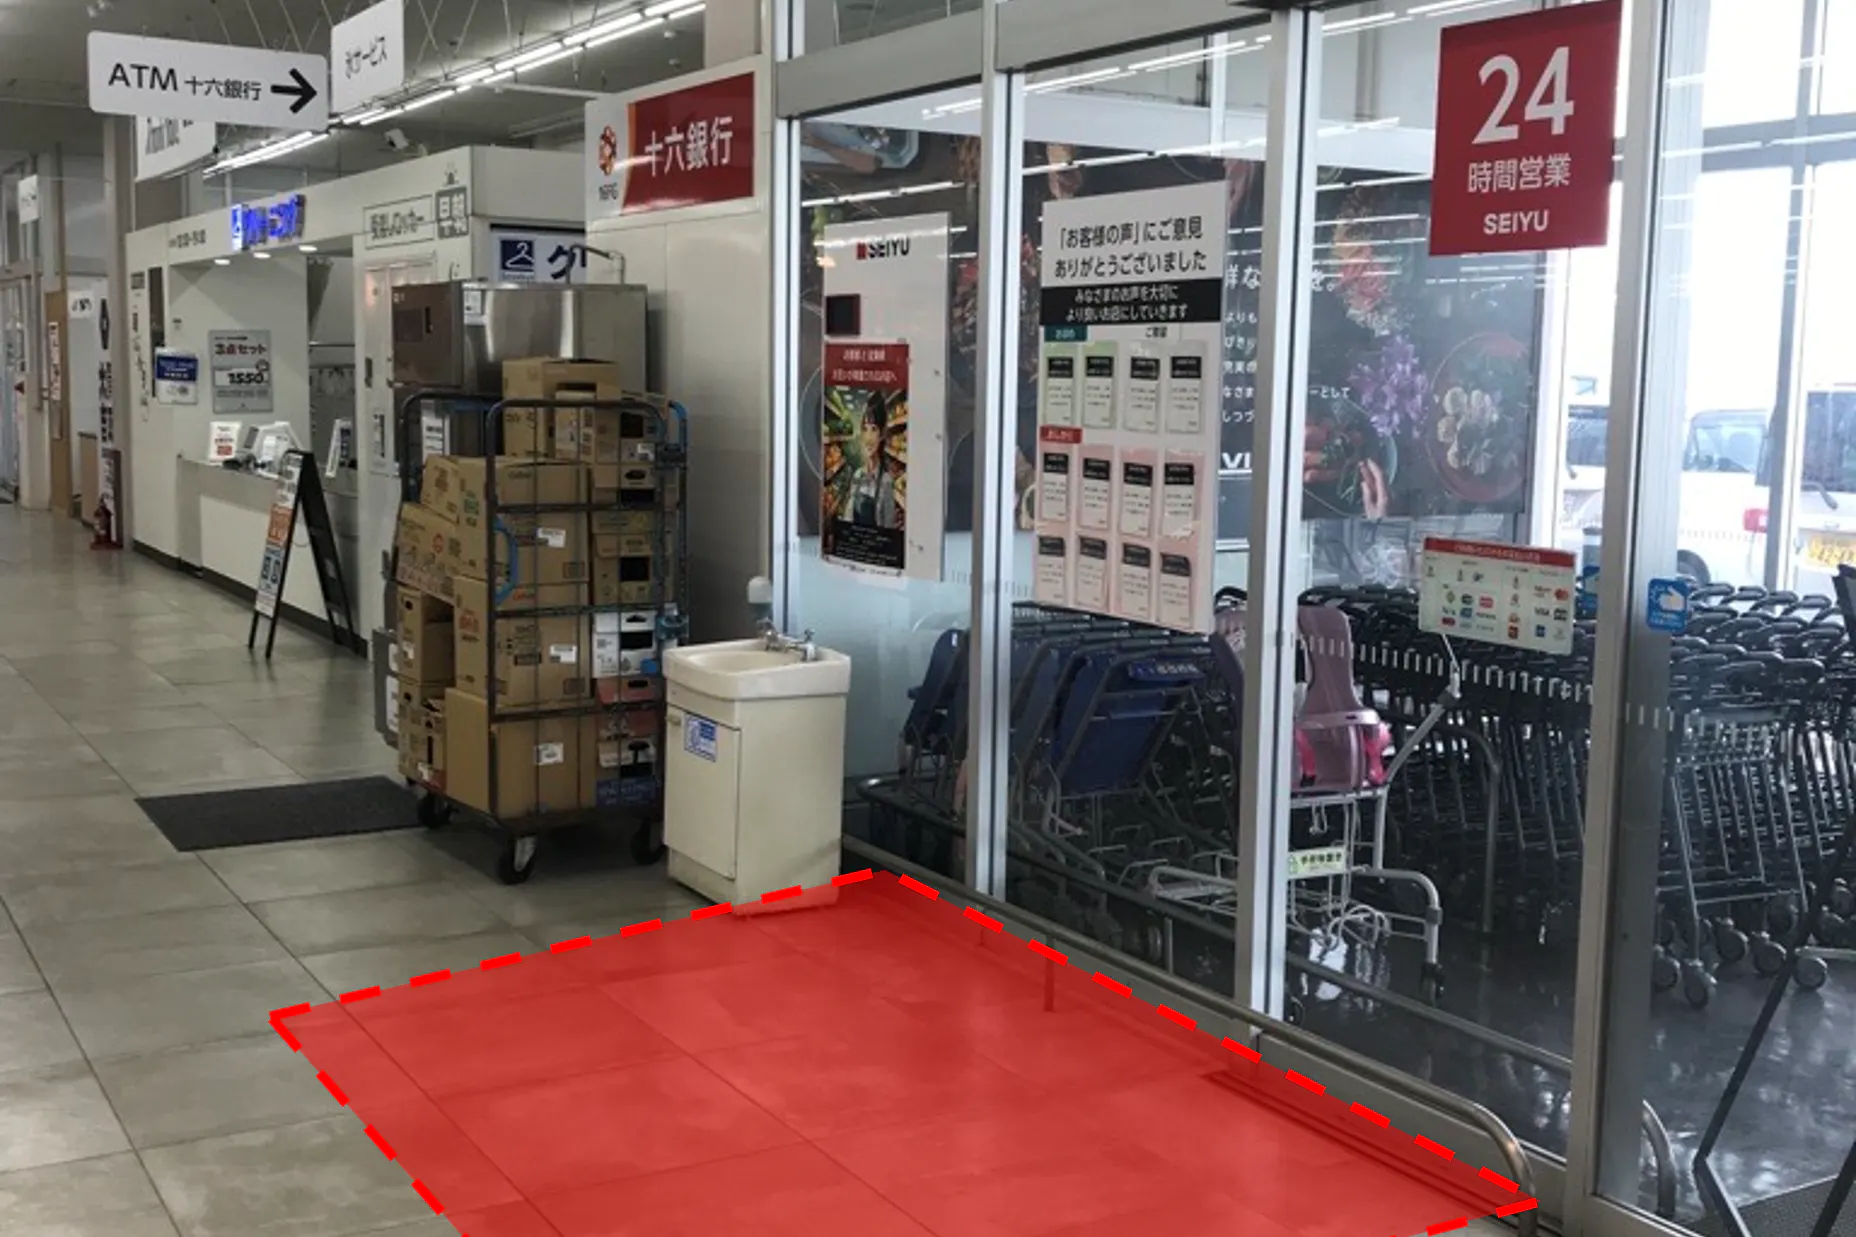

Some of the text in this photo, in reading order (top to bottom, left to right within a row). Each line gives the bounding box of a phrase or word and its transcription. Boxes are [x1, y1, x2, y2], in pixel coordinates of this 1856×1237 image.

[108, 62, 262, 101] ATM 十六銀行
[1471, 46, 1575, 145] 24
[644, 115, 733, 178] 十六銀行
[1467, 152, 1571, 193] 時間営業
[1060, 215, 1204, 249] 「お客様の声」にご意見
[1483, 210, 1550, 236] SEIYU
[869, 238, 910, 259] SEIYU
[1055, 250, 1207, 279] ありがとうございました
